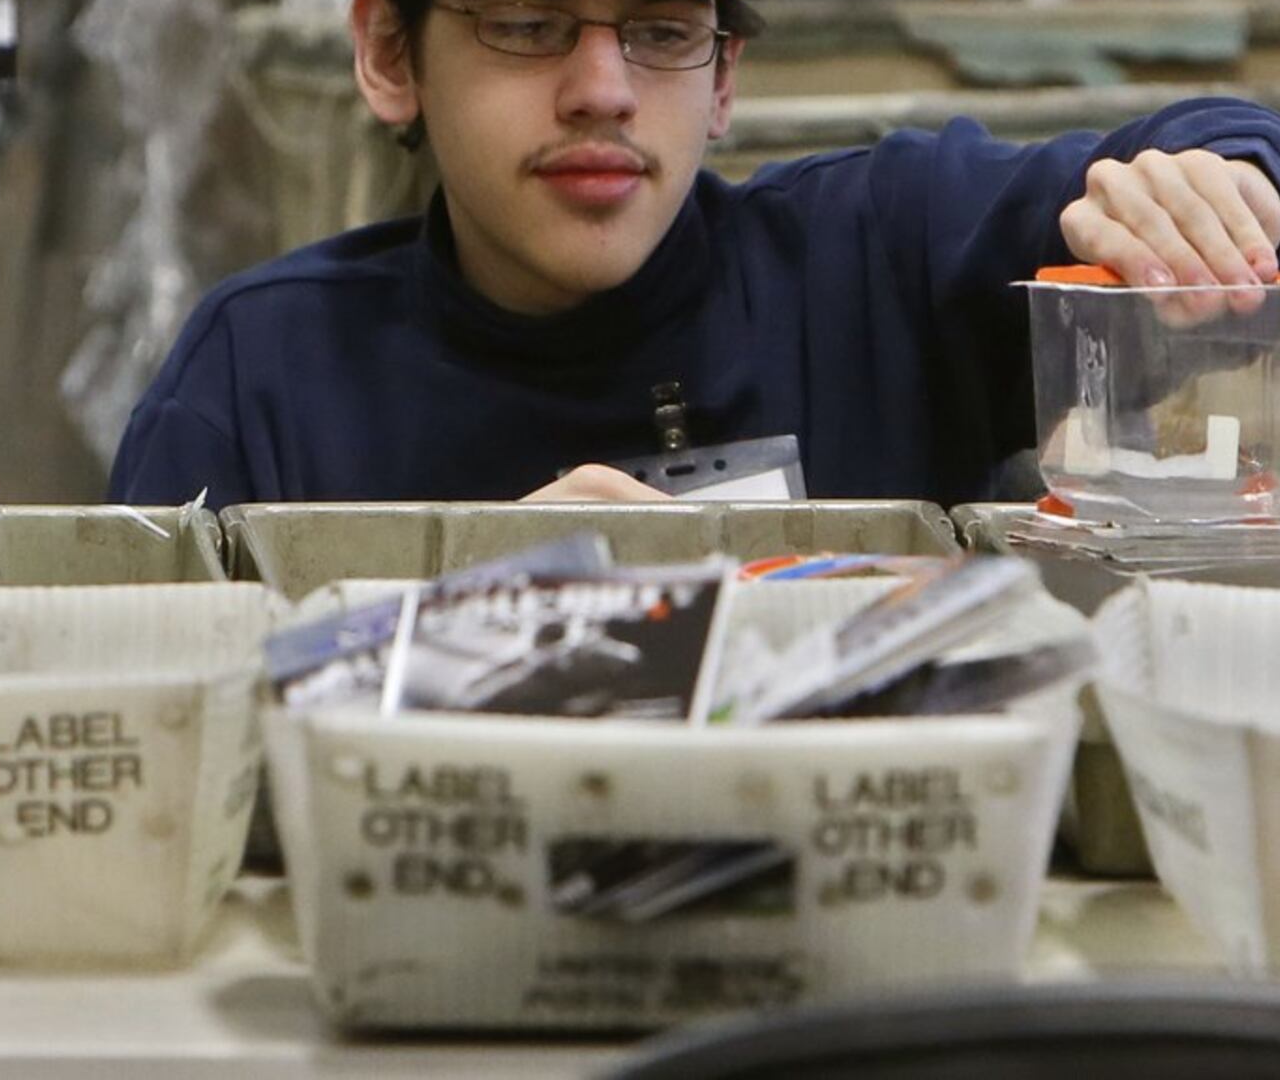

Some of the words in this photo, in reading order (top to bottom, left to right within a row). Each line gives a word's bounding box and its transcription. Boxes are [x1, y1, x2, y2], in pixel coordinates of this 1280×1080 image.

[361, 760, 518, 802] LABEL
[812, 768, 972, 810] LABEL
[16, 798, 114, 839] END
[360, 809, 529, 852] OTHER
[811, 813, 979, 857] OTHER
[391, 853, 492, 897] END
[842, 859, 945, 901] END
